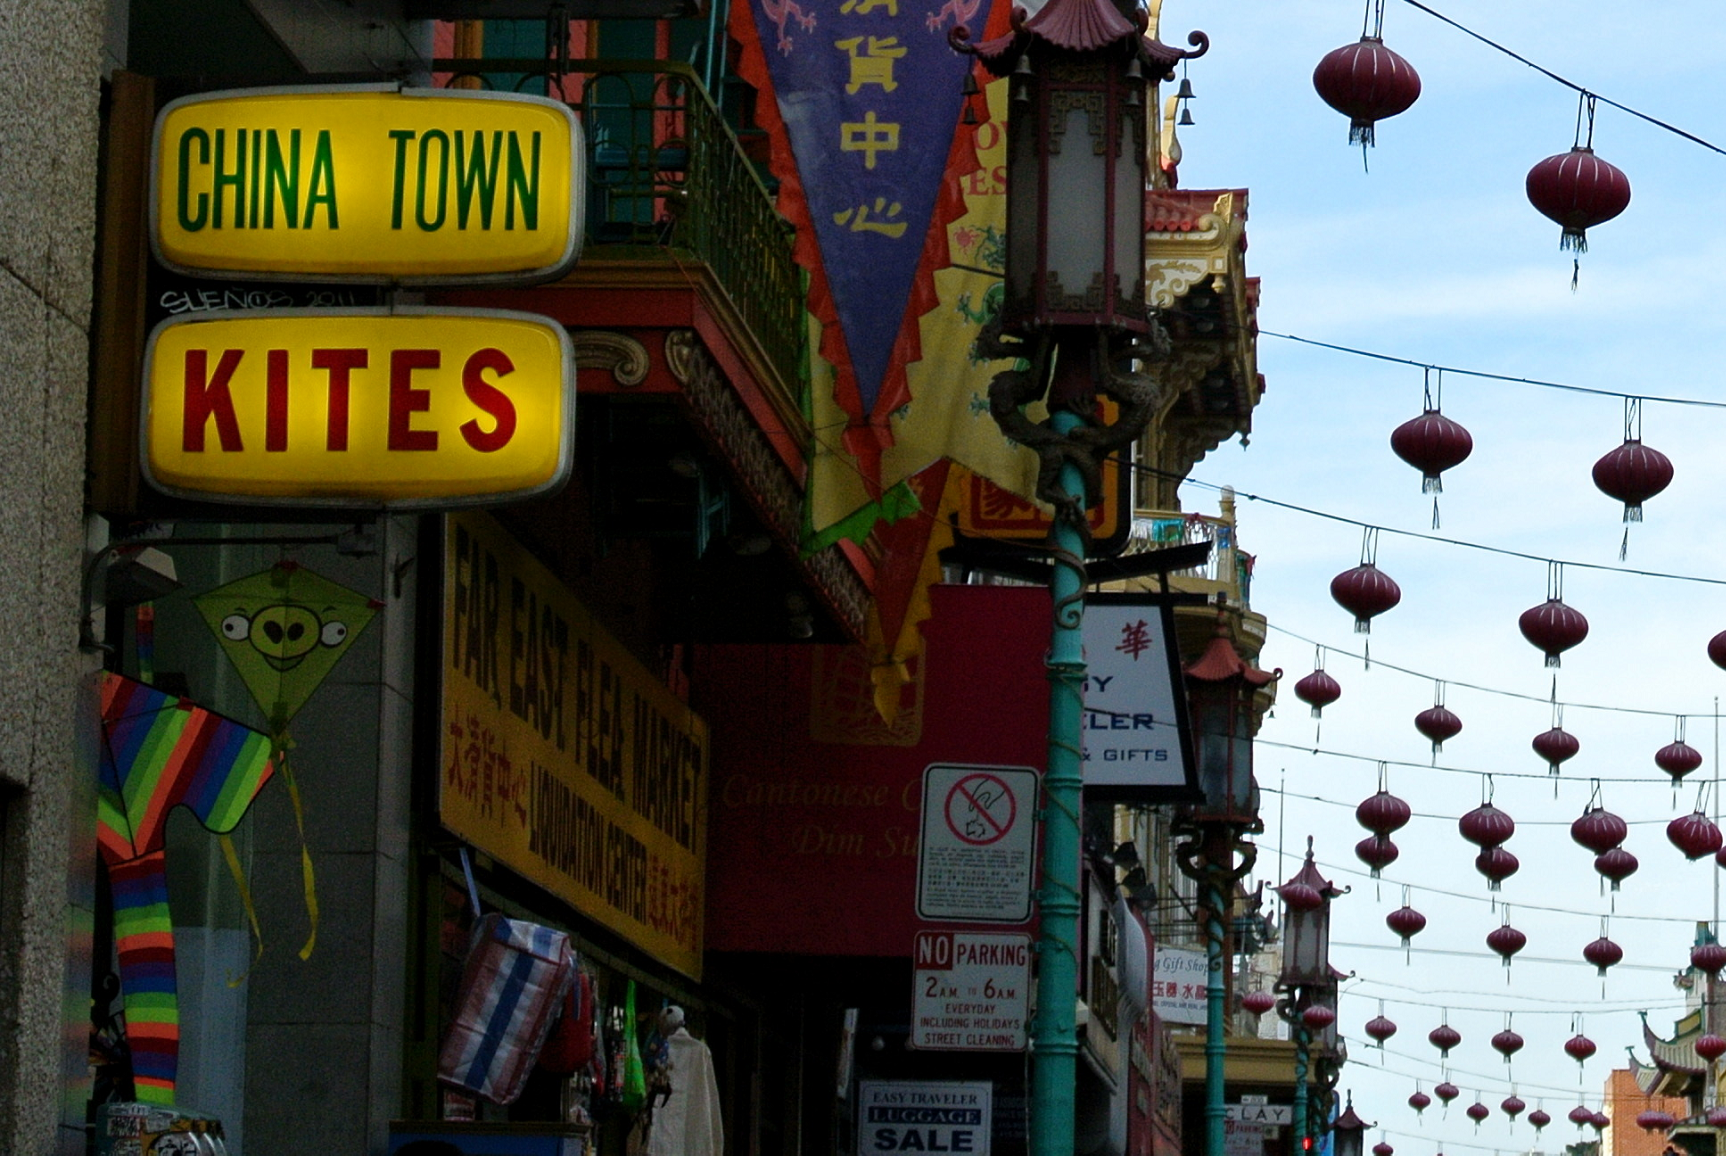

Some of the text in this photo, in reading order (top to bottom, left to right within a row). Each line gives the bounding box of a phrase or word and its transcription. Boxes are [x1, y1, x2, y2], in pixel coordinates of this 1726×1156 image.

[176, 125, 542, 232] CHINA TOWN
[181, 347, 519, 454] KITES
[1114, 618, 1153, 662] 華
[453, 524, 503, 710] FAR
[509, 575, 568, 753] EAST
[575, 637, 625, 805] FLEA
[1103, 748, 1168, 762] GIFTS
[919, 934, 1026, 966] NO PARKING
[1163, 956, 1184, 974] Gift
[945, 1003, 996, 1015] EVERYDAY
[920, 1017, 1020, 1030] INCLUDING HOLIDAYS
[924, 1033, 1015, 1046] STREET CLEANING
[873, 1092, 977, 1105] EASY TRAVELER
[873, 1108, 978, 1123] LUGGAGE
[1226, 1108, 1284, 1121] CLAY
[875, 1129, 973, 1152] SALE
